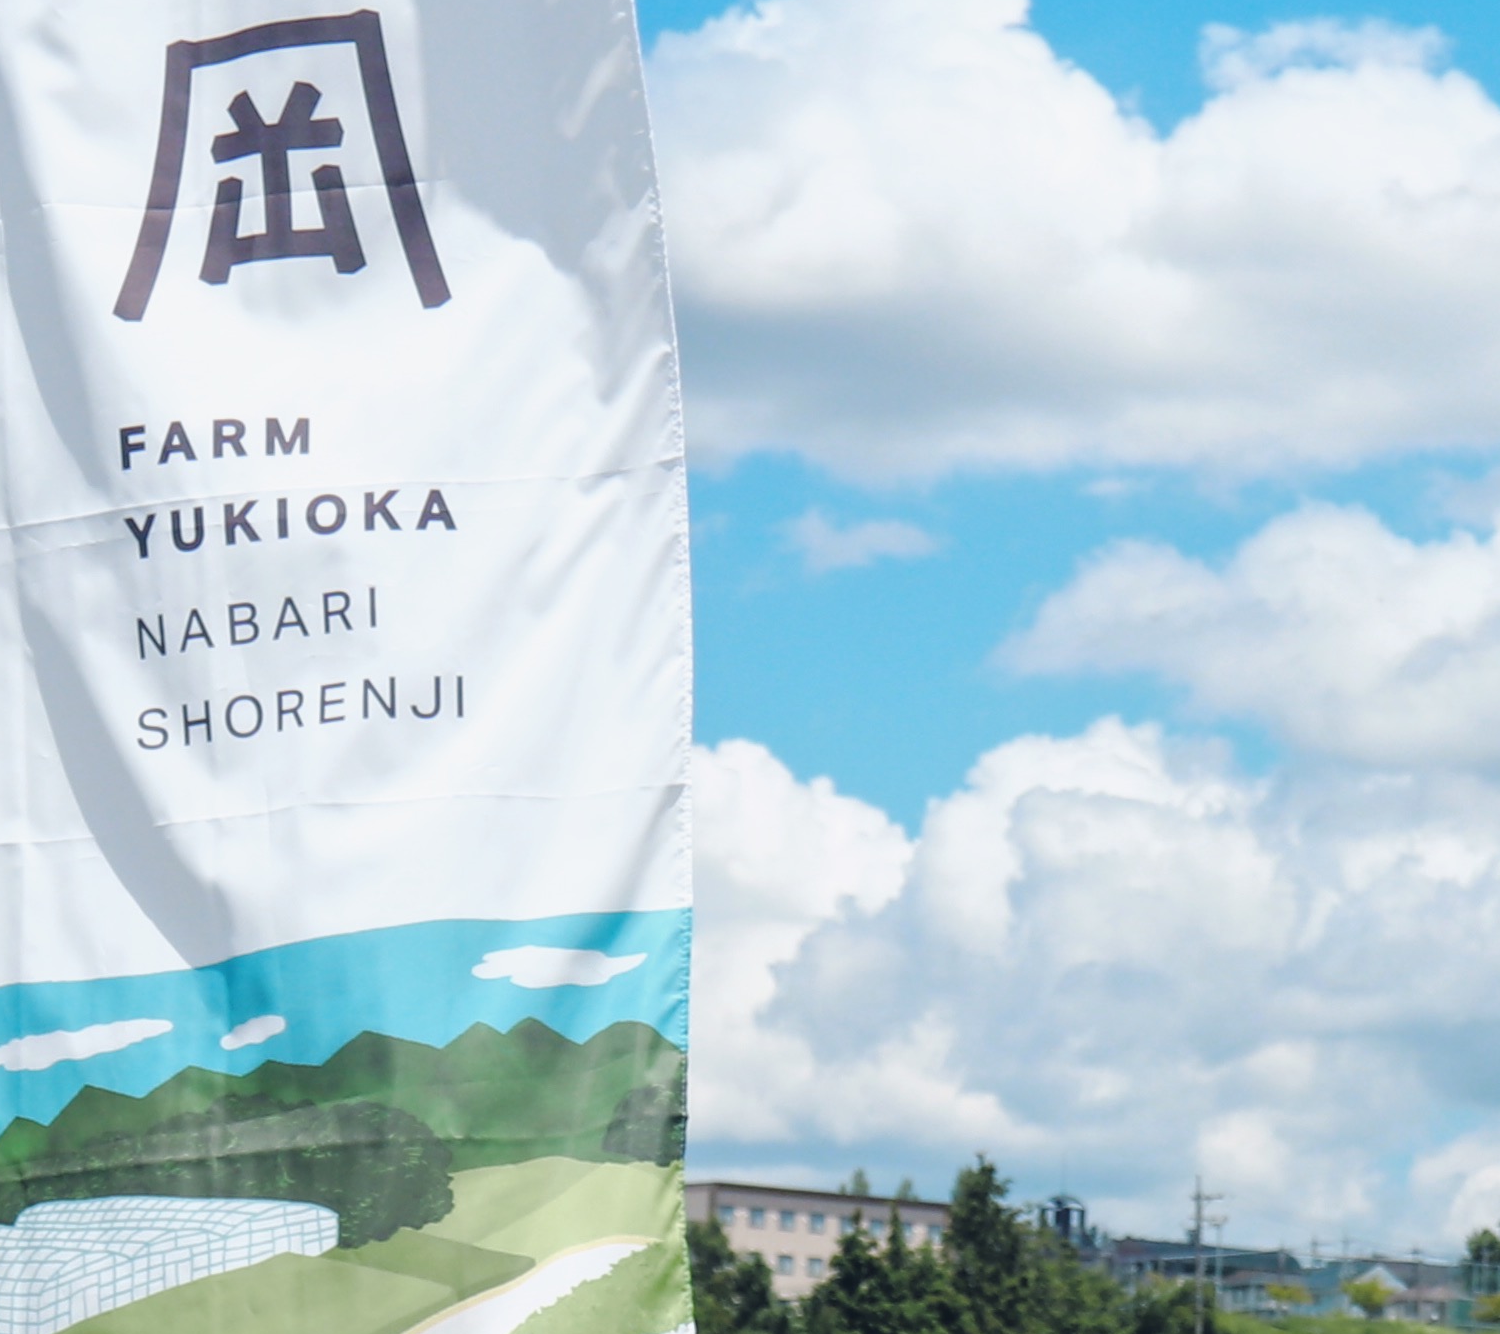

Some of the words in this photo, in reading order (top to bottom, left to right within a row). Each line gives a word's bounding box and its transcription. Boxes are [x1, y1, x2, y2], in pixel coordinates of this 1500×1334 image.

[118, 417, 311, 471] FARM
[123, 488, 458, 559] YUKIOKA
[135, 586, 378, 660] NABARI
[136, 675, 465, 751] SHORENJI
